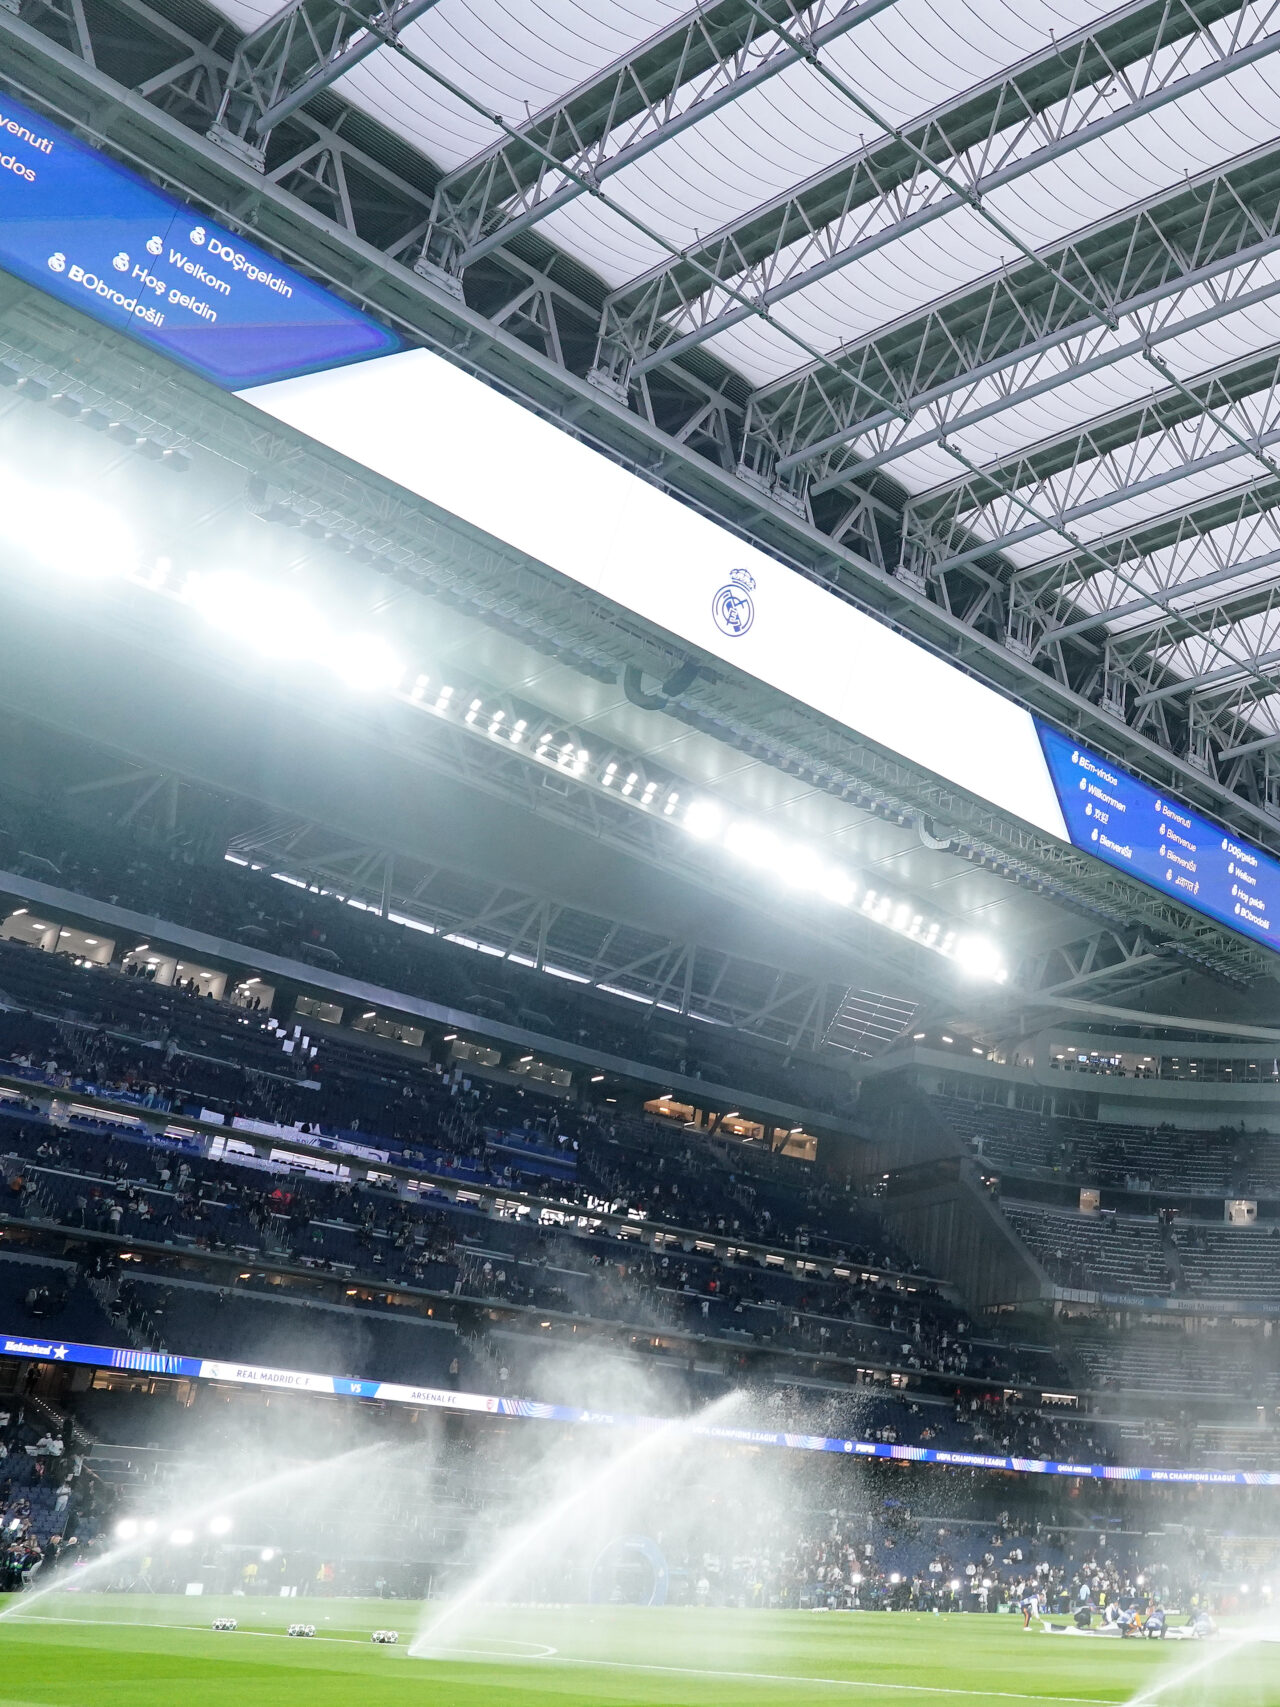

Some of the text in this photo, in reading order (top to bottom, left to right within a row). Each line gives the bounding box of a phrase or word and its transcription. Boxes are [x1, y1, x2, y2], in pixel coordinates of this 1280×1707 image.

[0, 152, 36, 182] dos
[168, 248, 232, 296] Welkom
[68, 264, 164, 328] BObrodošli
[132, 264, 218, 323] Hoş geldin
[1088, 784, 1126, 812] Willkommen
[1162, 805, 1191, 828] Benvenuti
[1166, 829, 1197, 852] Bienvenue
[1235, 867, 1257, 886] Welkom
[236, 1369, 257, 1380] REAL
[260, 1372, 294, 1384] MADRID
[350, 1383, 362, 1393] VS
[411, 1391, 457, 1404] ARSENAL FC
[936, 1452, 1006, 1467] UEFA CHAMPIONS LEAGUE
[1152, 1471, 1168, 1479] UEFA
[1169, 1472, 1209, 1481] CHAMPIONS
